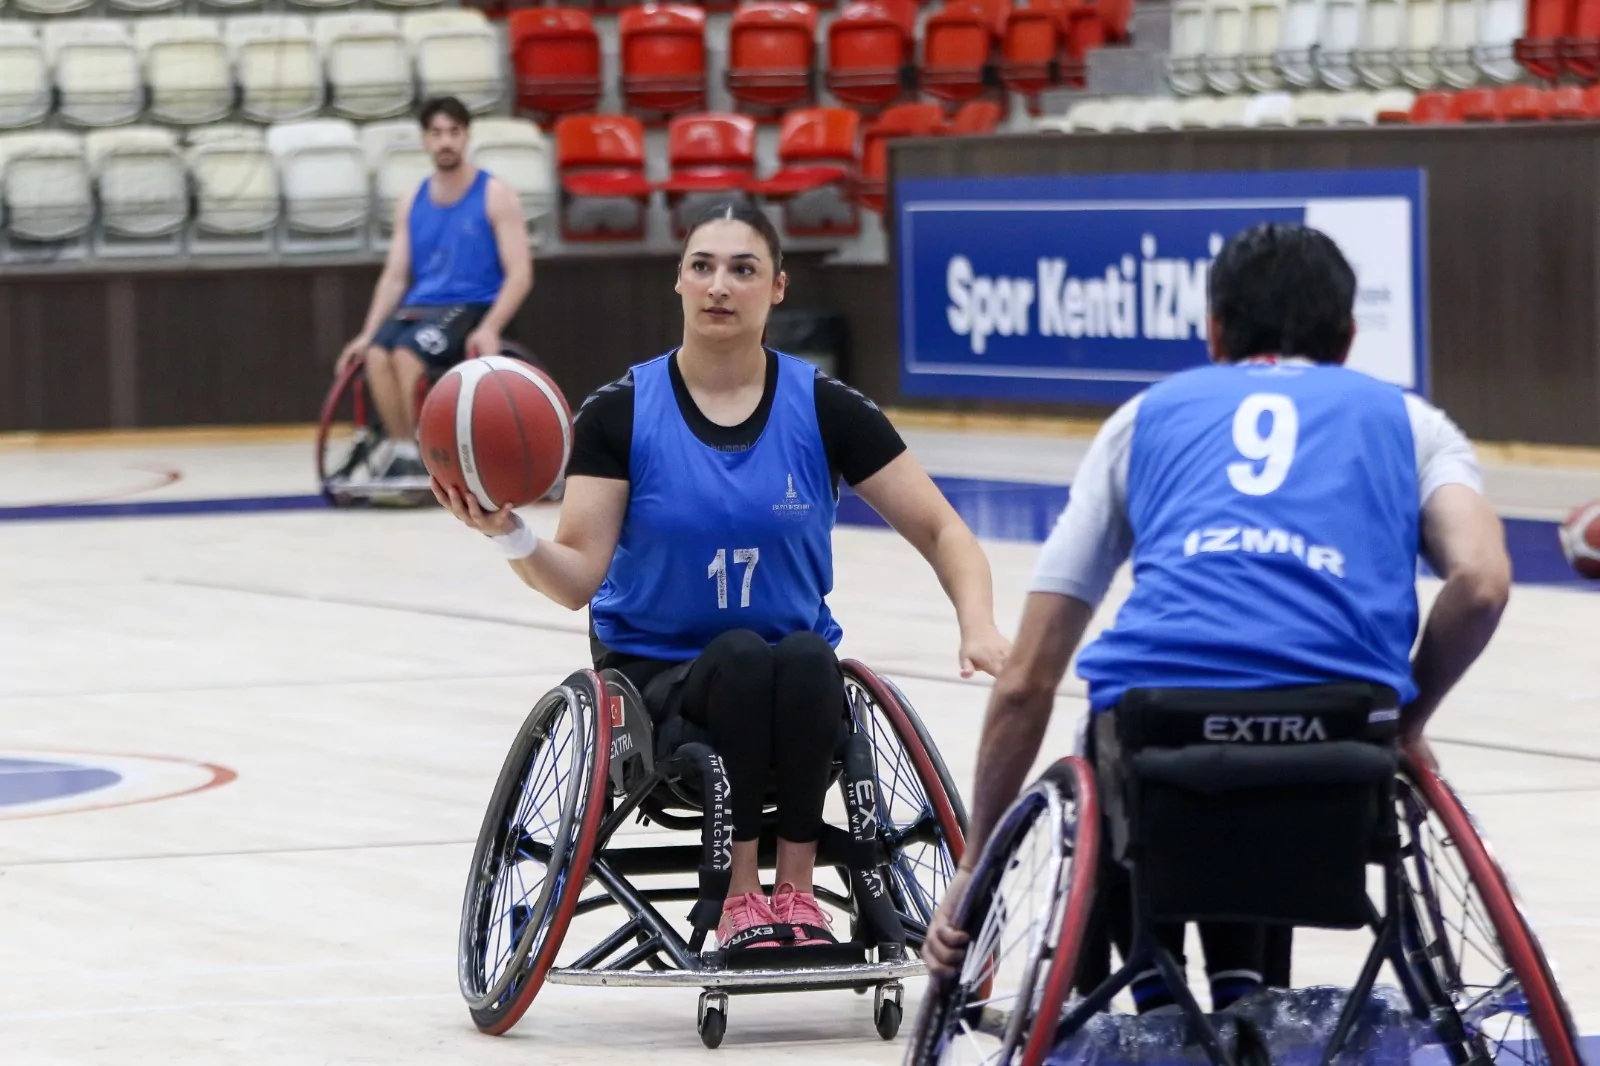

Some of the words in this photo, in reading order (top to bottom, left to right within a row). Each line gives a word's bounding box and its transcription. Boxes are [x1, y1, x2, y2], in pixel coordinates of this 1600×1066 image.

[947, 254, 1035, 355] Spor
[1037, 253, 1137, 339] Kenti
[1141, 231, 1224, 341] İZM
[1226, 392, 1299, 496] 9
[707, 547, 759, 609] 17
[1203, 716, 1327, 742] EXTRA
[708, 754, 721, 773] THE
[847, 782, 857, 806] THE
